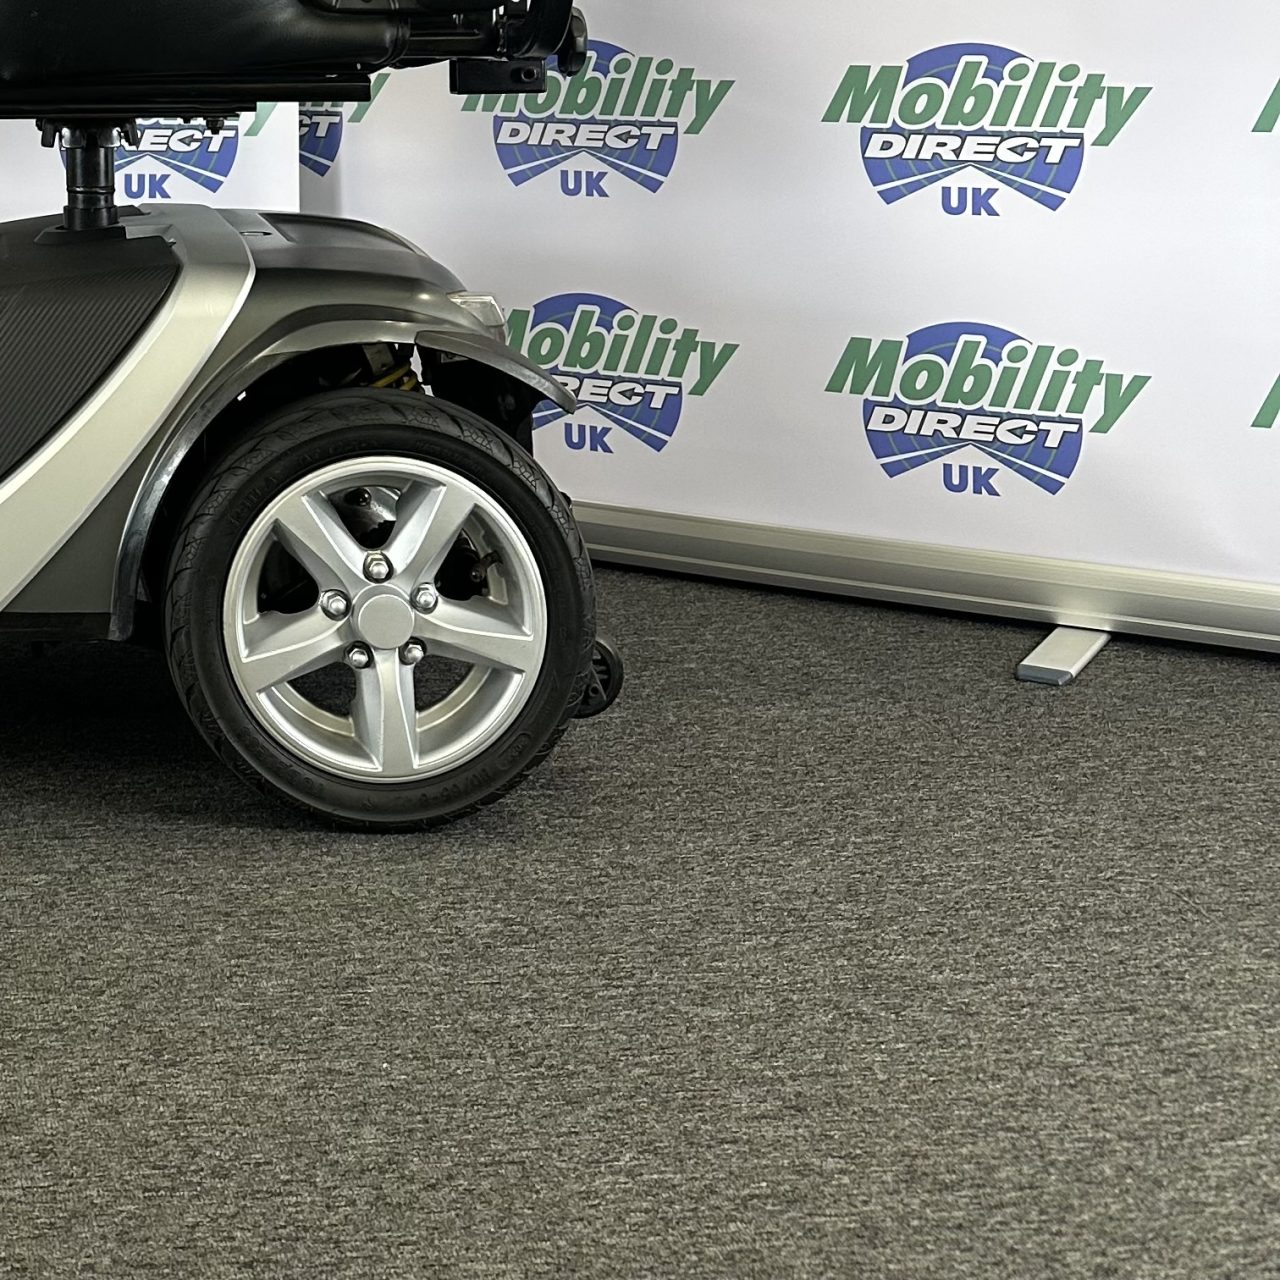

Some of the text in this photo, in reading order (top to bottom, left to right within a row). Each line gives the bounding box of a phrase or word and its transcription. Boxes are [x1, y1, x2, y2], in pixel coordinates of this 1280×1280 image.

[819, 59, 1152, 146] Mobility
[496, 118, 675, 150] DIRECT
[864, 130, 1081, 164] DIRECT
[124, 174, 171, 199] UK
[560, 170, 609, 198] UK
[941, 187, 1000, 217] UK
[822, 336, 1151, 433] Mobility
[564, 423, 614, 454] UK
[866, 403, 1079, 448] DIRECT
[942, 463, 1001, 497] UK
